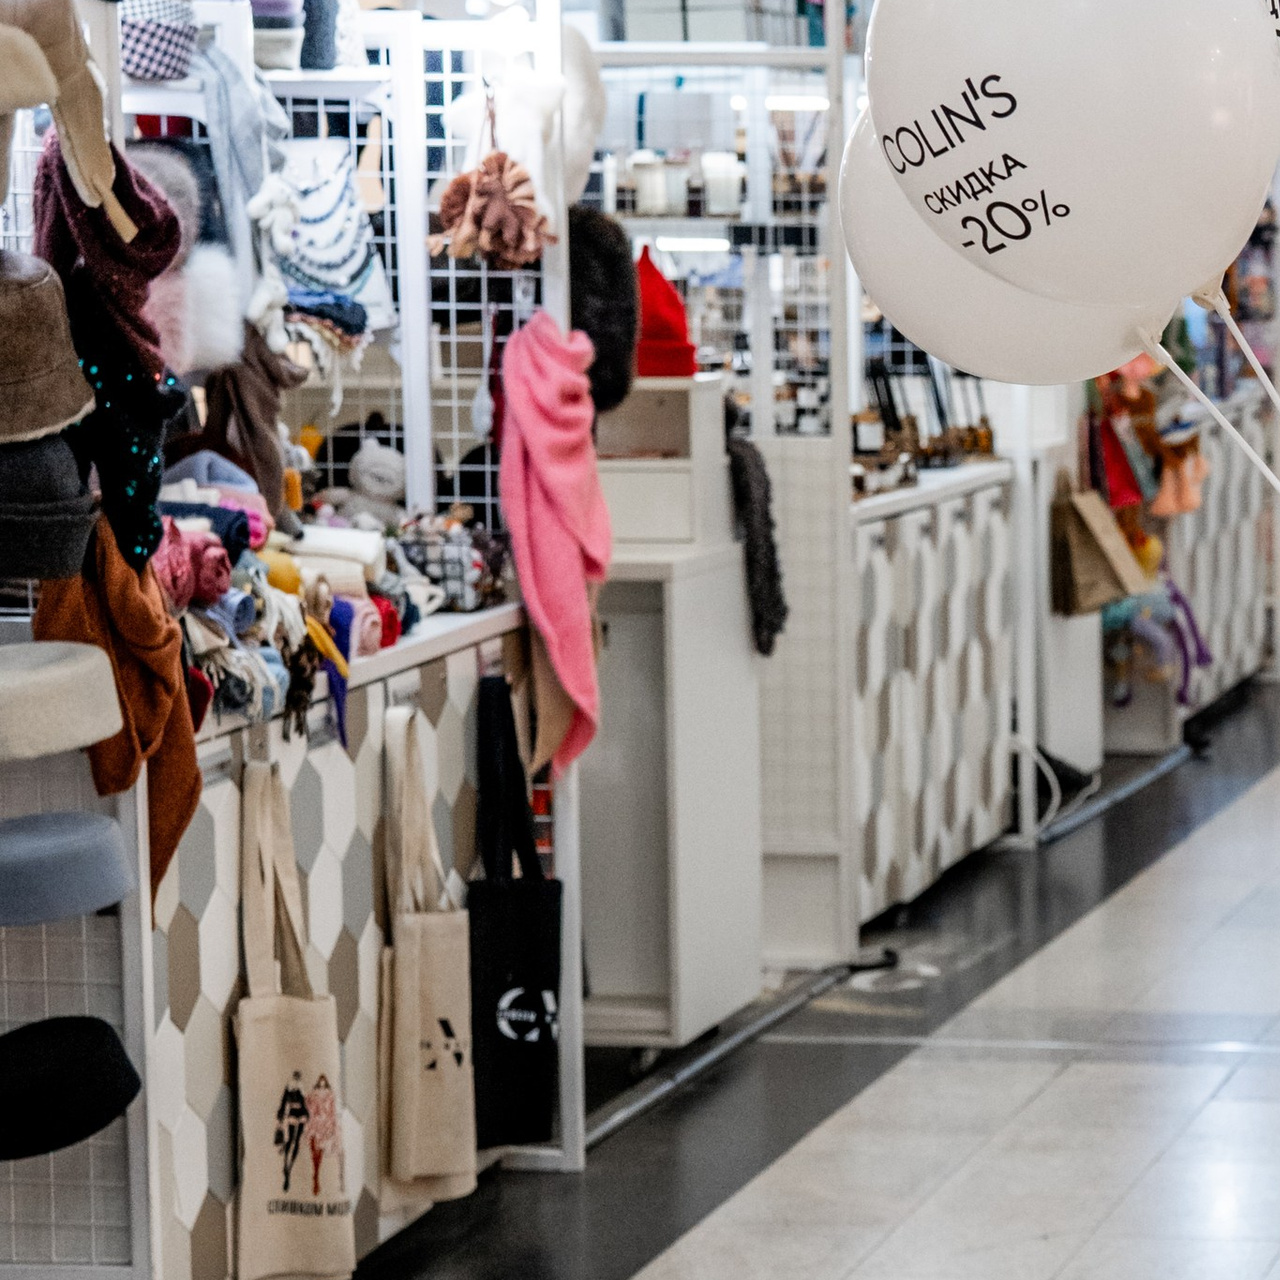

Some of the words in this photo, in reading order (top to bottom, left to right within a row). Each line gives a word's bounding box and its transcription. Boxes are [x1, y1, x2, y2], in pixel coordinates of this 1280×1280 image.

[882, 74, 1018, 175] COLIN'S
[923, 152, 1028, 215] СКИДКА
[960, 188, 1071, 255] -20%
